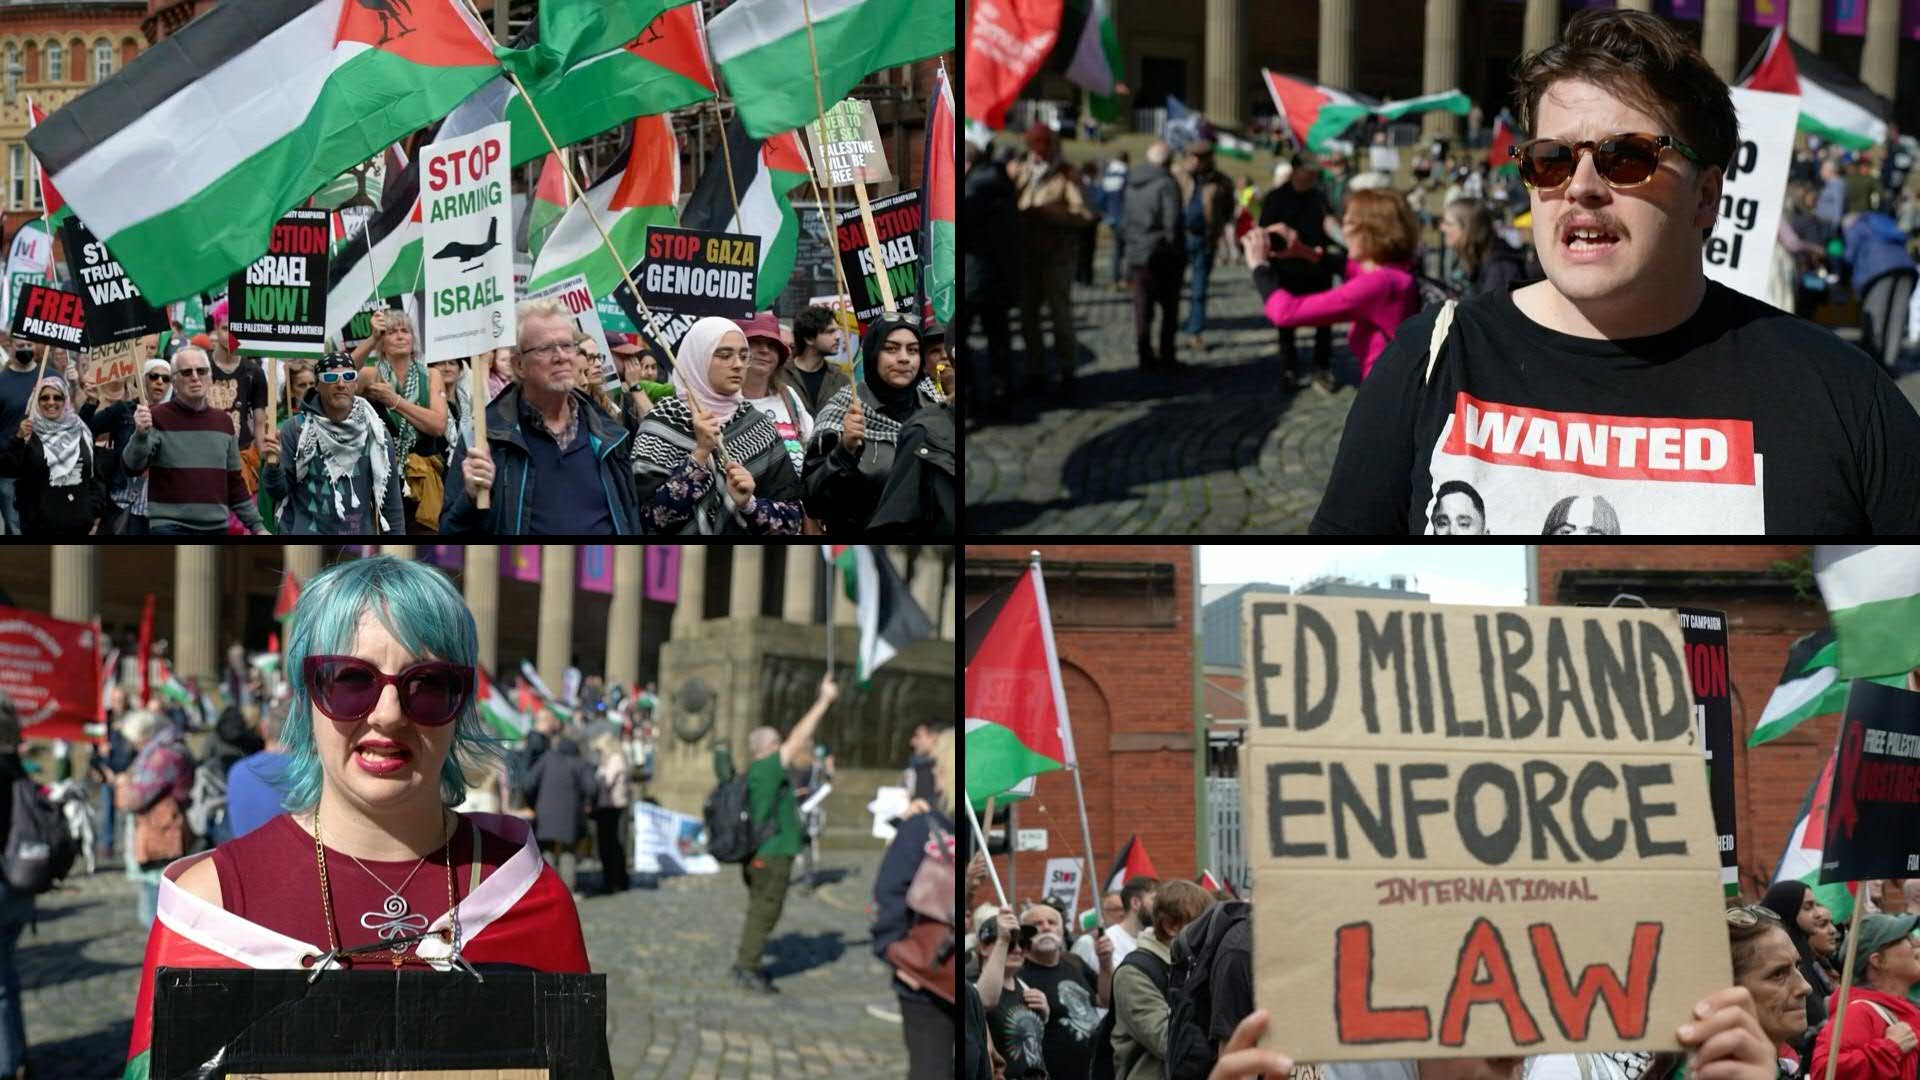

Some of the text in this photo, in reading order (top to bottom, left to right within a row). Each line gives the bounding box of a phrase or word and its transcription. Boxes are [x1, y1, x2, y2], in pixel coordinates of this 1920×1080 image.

[813, 115, 861, 131] RVER TO
[840, 127, 860, 141] SEA
[428, 138, 501, 192] STOP
[819, 140, 876, 158] PALESTINE
[851, 154, 866, 167] BE
[825, 169, 854, 184] REE
[430, 181, 502, 224] ARMING
[892, 191, 918, 205] CAMPAIGN
[270, 225, 327, 255] CTION
[837, 204, 921, 252] SACTION
[83, 241, 110, 265] ST
[649, 232, 754, 267] STOP GAZA
[858, 235, 919, 276] ISRAEL
[246, 255, 311, 287] ISRAEL
[646, 263, 754, 301] GENOCIDE
[26, 287, 86, 328] FREE
[245, 286, 309, 322] NOW!
[433, 275, 504, 318] ISRAEL
[22, 317, 84, 344] PALESTINE
[229, 322, 243, 332] FREE
[243, 323, 273, 334] PALESTINE
[277, 324, 291, 334] END
[291, 325, 324, 336] APARTHEID
[95, 360, 135, 385] LAW
[1465, 402, 1728, 472] WANTED
[1689, 612, 1722, 631] CAMPAIGN
[1252, 602, 1339, 731] ED
[1356, 608, 1697, 746] MILIBAND,
[1863, 728, 1888, 755] FREE
[1857, 760, 1920, 803] HOSTAGE
[1265, 760, 1689, 866] ENFORCE
[1375, 876, 1598, 906] INTERNATIONAL
[1334, 916, 1664, 1047] LAW
